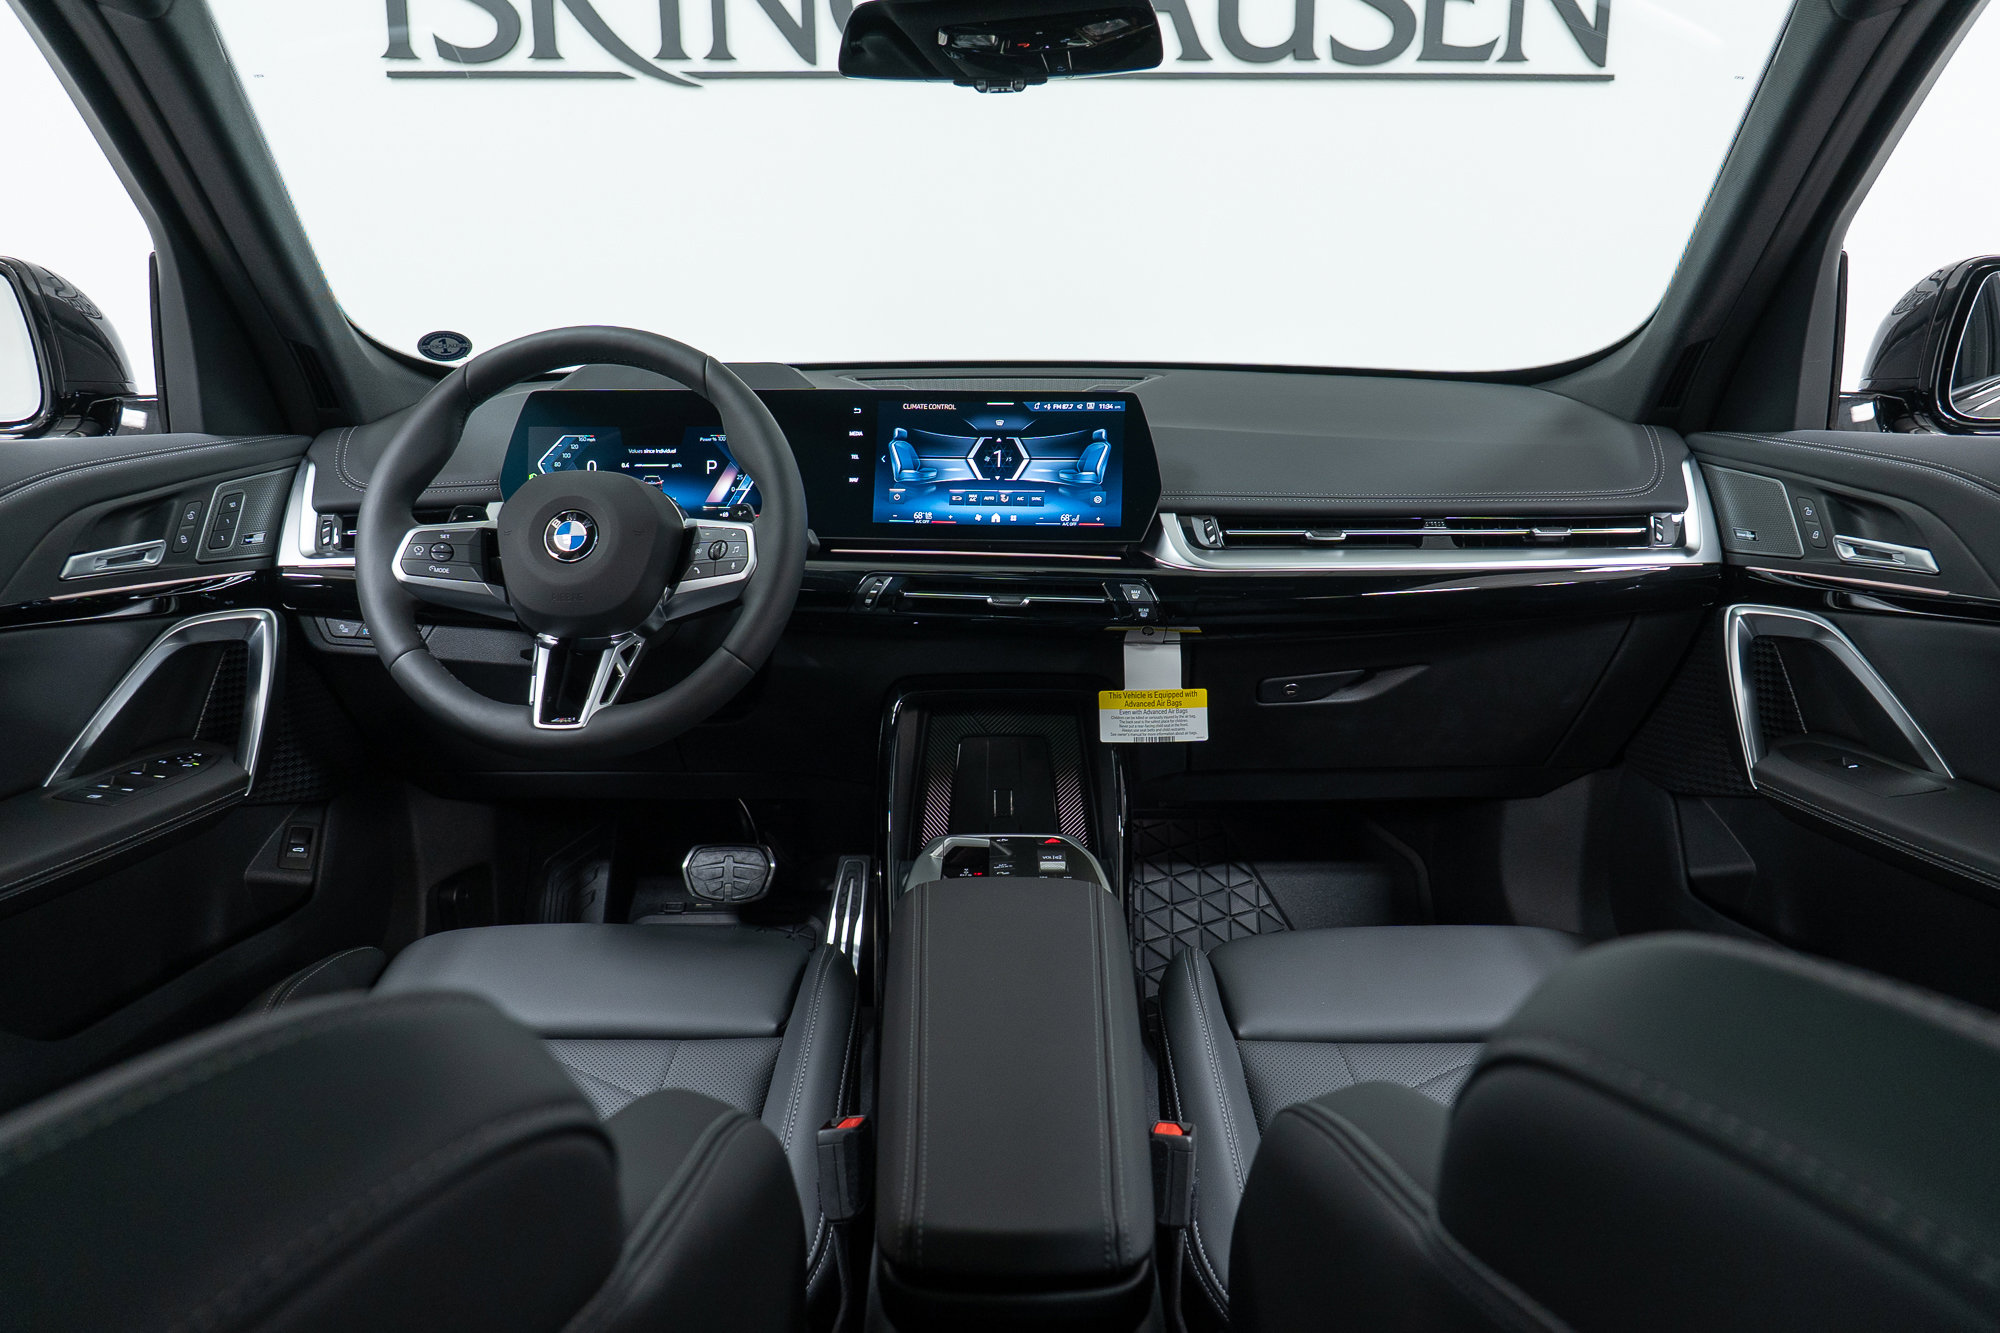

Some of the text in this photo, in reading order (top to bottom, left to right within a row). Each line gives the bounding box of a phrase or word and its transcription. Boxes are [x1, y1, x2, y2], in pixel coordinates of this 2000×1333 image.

[994, 450, 1001, 468] 1
[706, 460, 717, 474] P
[1154, 691, 1183, 699] Equipped
